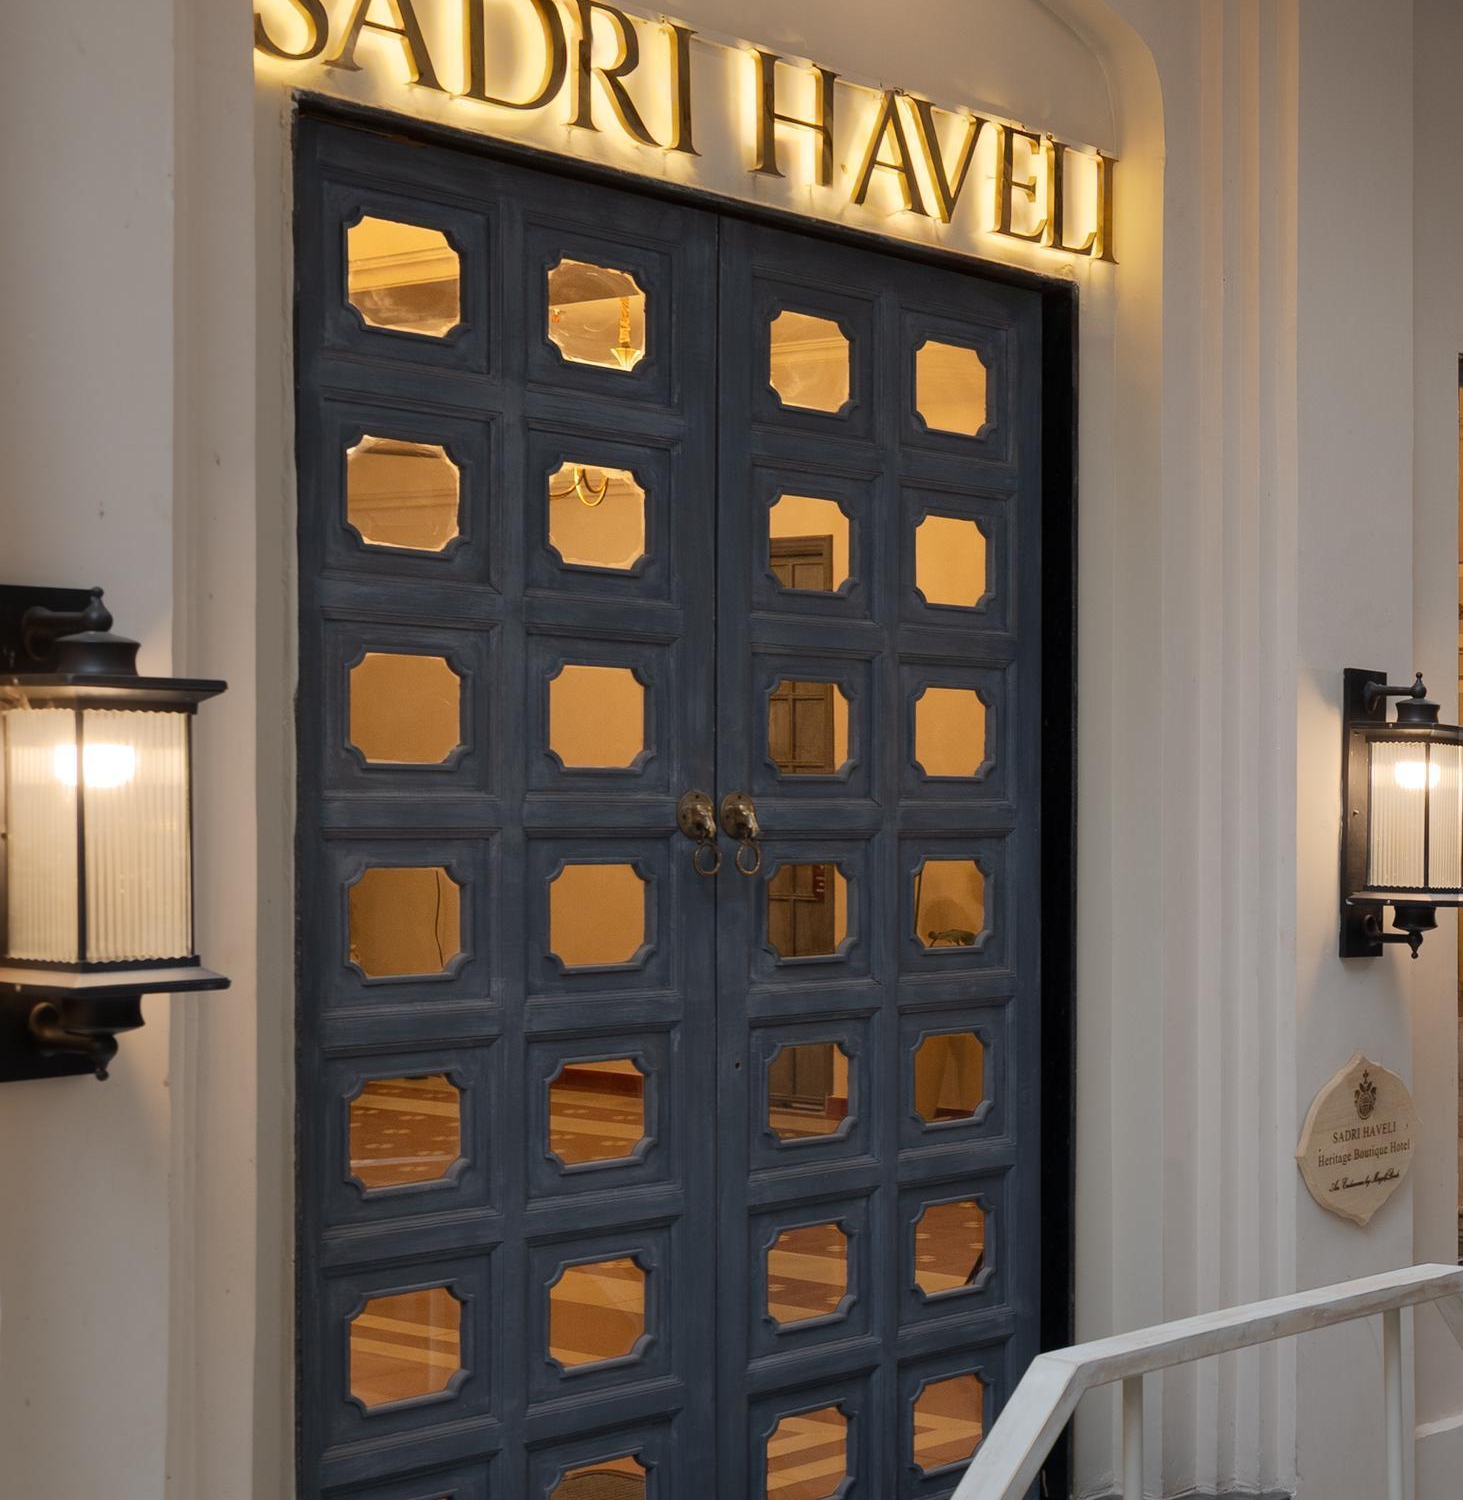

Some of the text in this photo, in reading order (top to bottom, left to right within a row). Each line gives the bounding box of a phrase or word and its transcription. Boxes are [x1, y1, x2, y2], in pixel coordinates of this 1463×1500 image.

[745, 47, 1122, 266] HAVELI
[1333, 1121, 1396, 1144] SADRI HAVELI
[1318, 1138, 1410, 1167] Heritage Boutique Hotel
